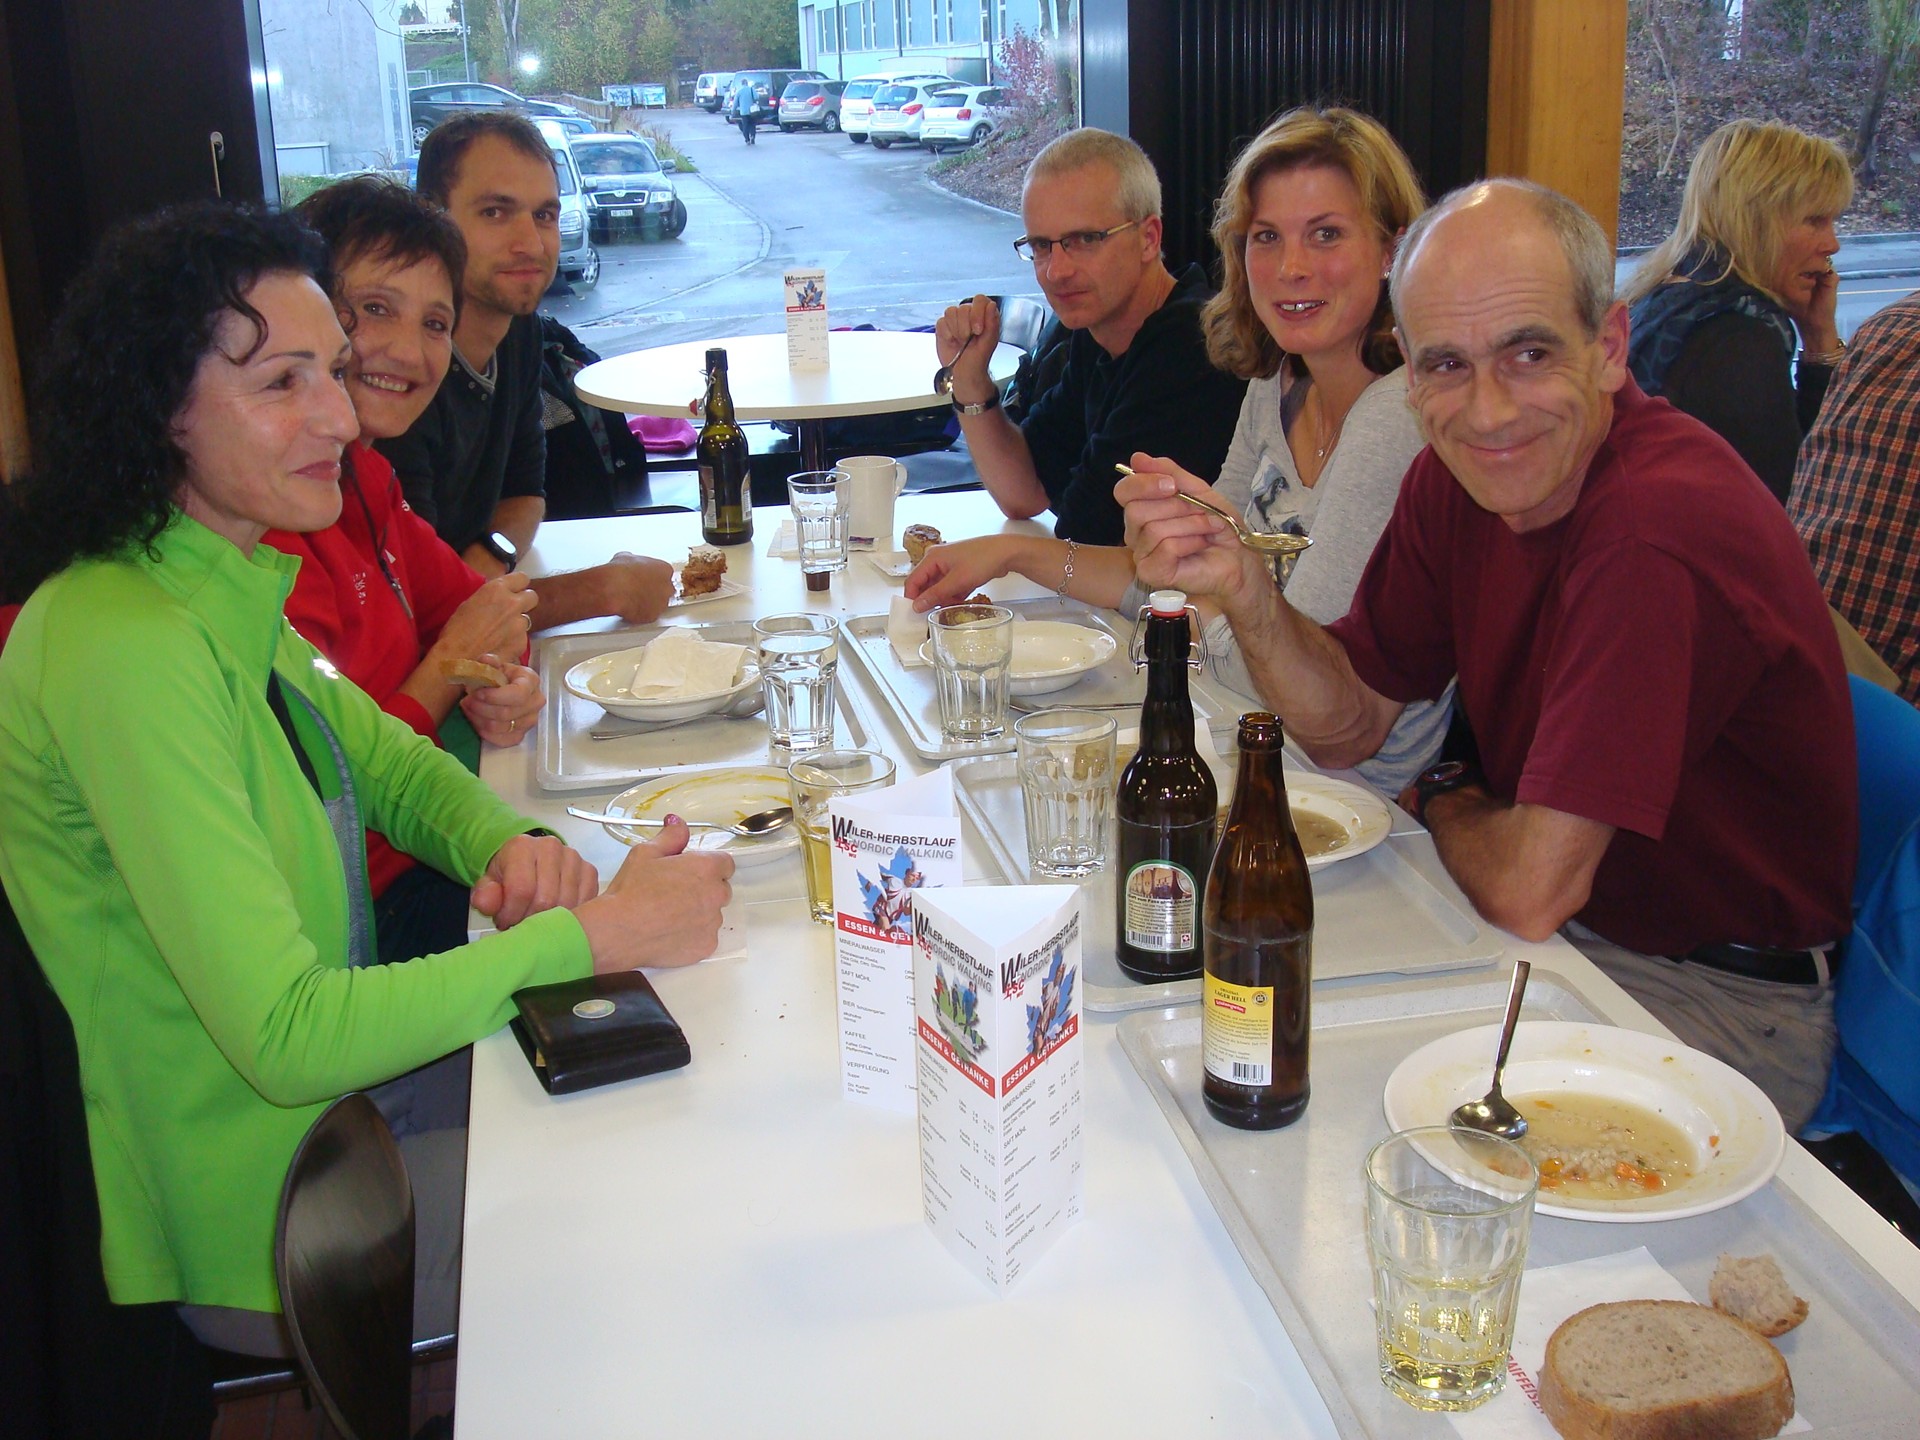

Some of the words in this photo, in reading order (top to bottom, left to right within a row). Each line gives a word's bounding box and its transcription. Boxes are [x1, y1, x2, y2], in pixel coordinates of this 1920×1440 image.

[832, 814, 957, 848] WILER-HERBSTLAUF
[853, 839, 894, 856] NORDIC
[844, 919, 876, 935] ESSEN
[878, 930, 887, 938] &
[914, 907, 994, 979] WILER-HERBSTLAUF
[929, 940, 956, 966] NORDIC
[957, 960, 992, 993] WALKING
[1001, 910, 1079, 994] WILER-HERBSTLAUF
[1214, 989, 1230, 999] LAGER
[922, 1026, 943, 1050] ESSEN
[943, 1046, 950, 1057] &
[1006, 1061, 1028, 1088] ESSEN
[1506, 1353, 1545, 1414] AIFFEISE
